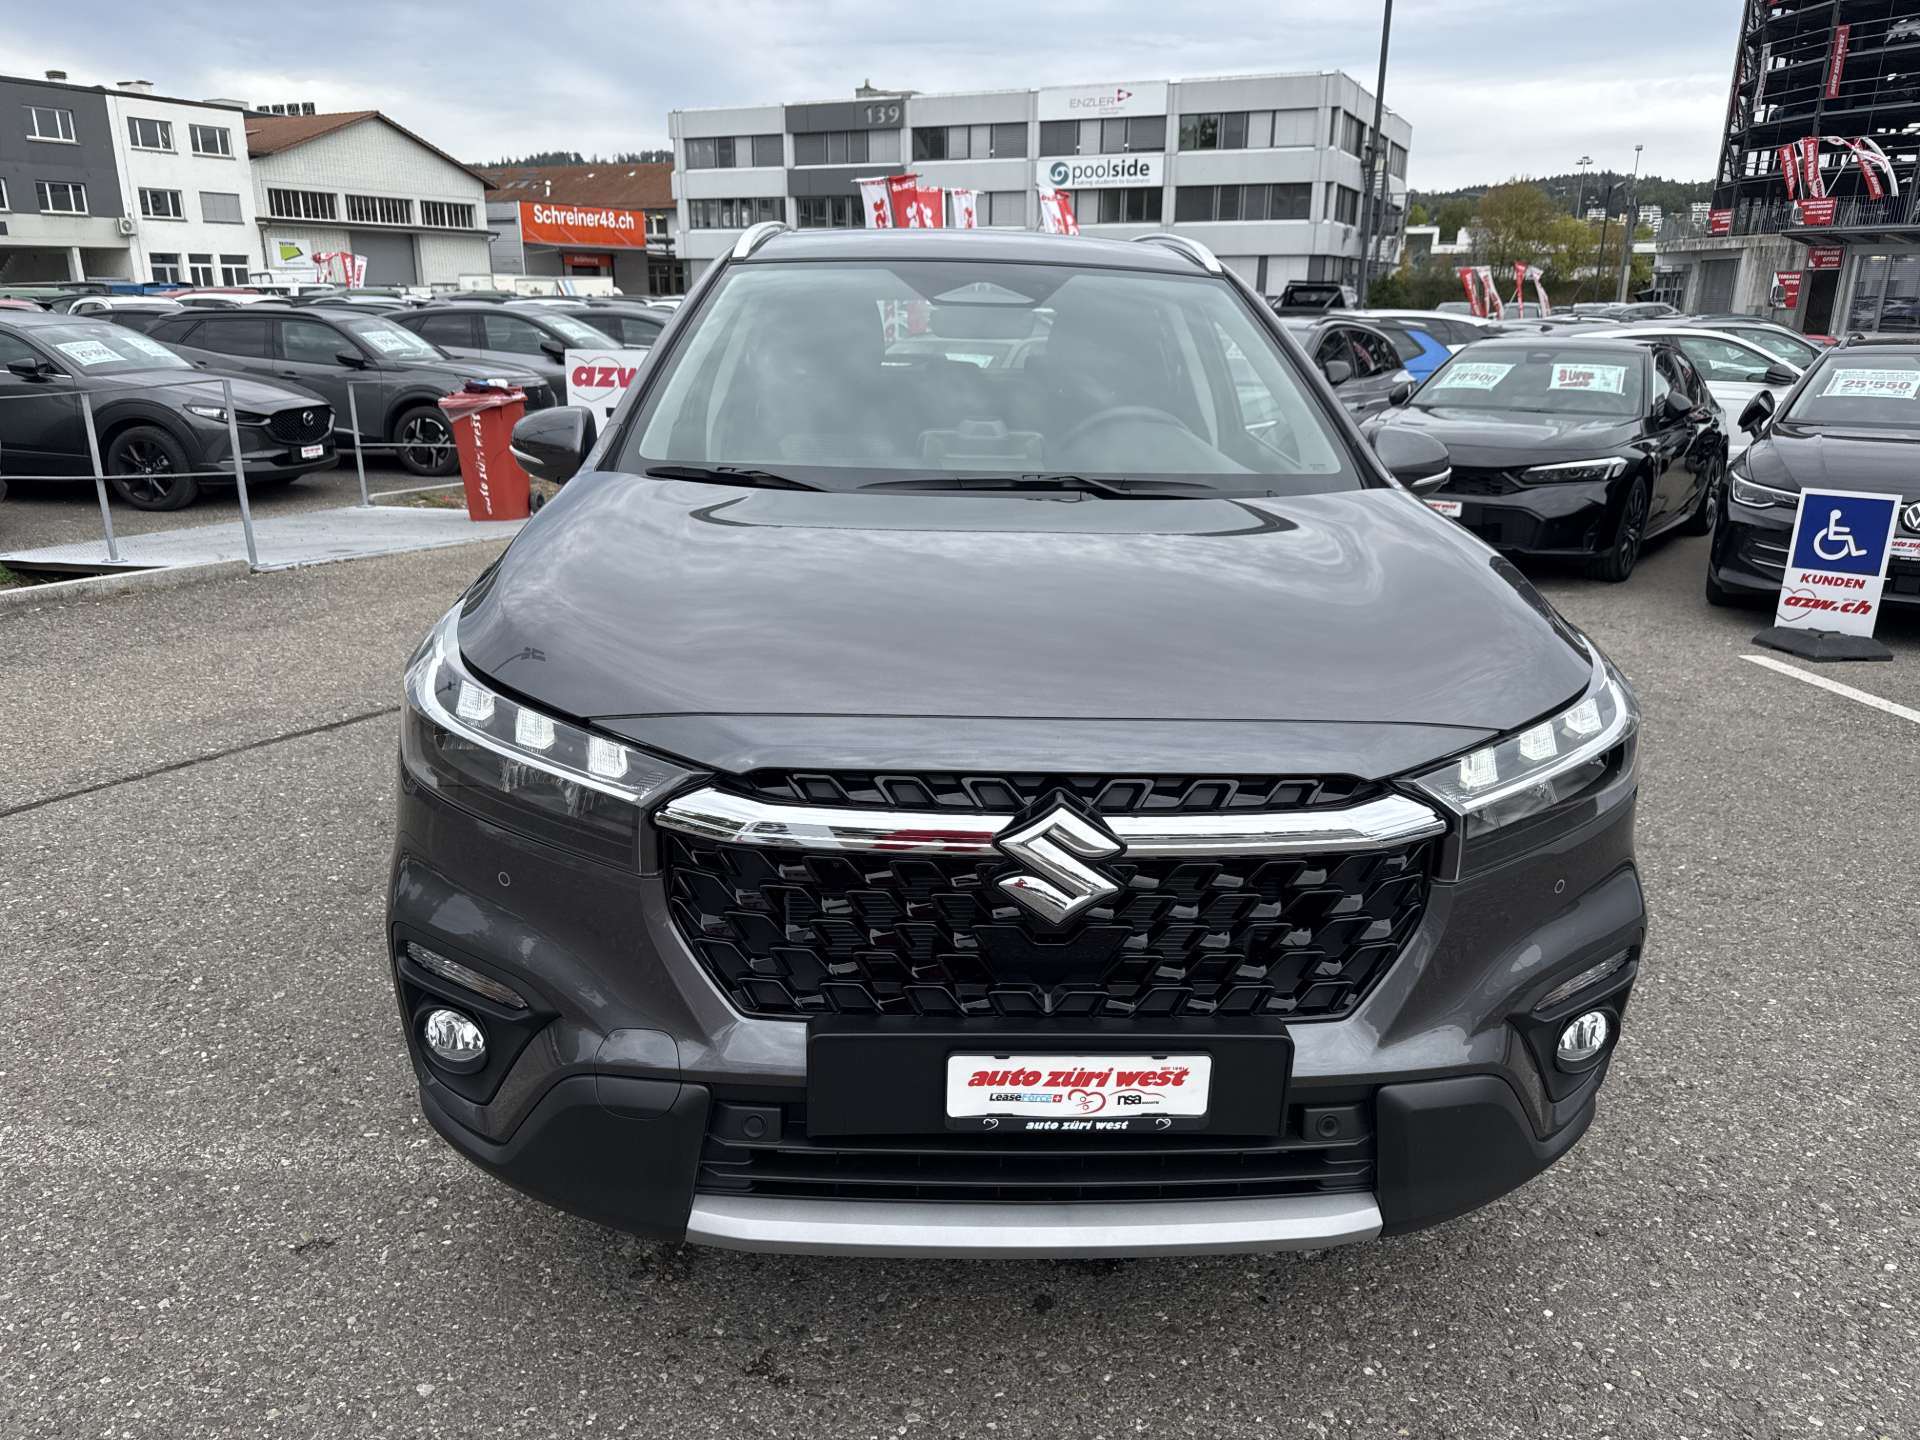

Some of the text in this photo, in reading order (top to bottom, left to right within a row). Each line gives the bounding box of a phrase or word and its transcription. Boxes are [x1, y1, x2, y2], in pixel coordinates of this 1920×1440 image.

[1069, 96, 1115, 108] ENZLER
[866, 106, 900, 124] 139
[1071, 158, 1151, 186] poolside
[533, 204, 635, 230] Schreiner48.ch
[1841, 379, 1912, 390] 25'550
[1799, 572, 1866, 590] KUNDEN
[1783, 595, 1873, 616] azw.ch
[968, 1066, 1190, 1088] auto züri west
[989, 1092, 1053, 1103] LeaseForce
[1116, 1094, 1142, 1105] nsa
[1025, 1120, 1129, 1130] auto züri west
